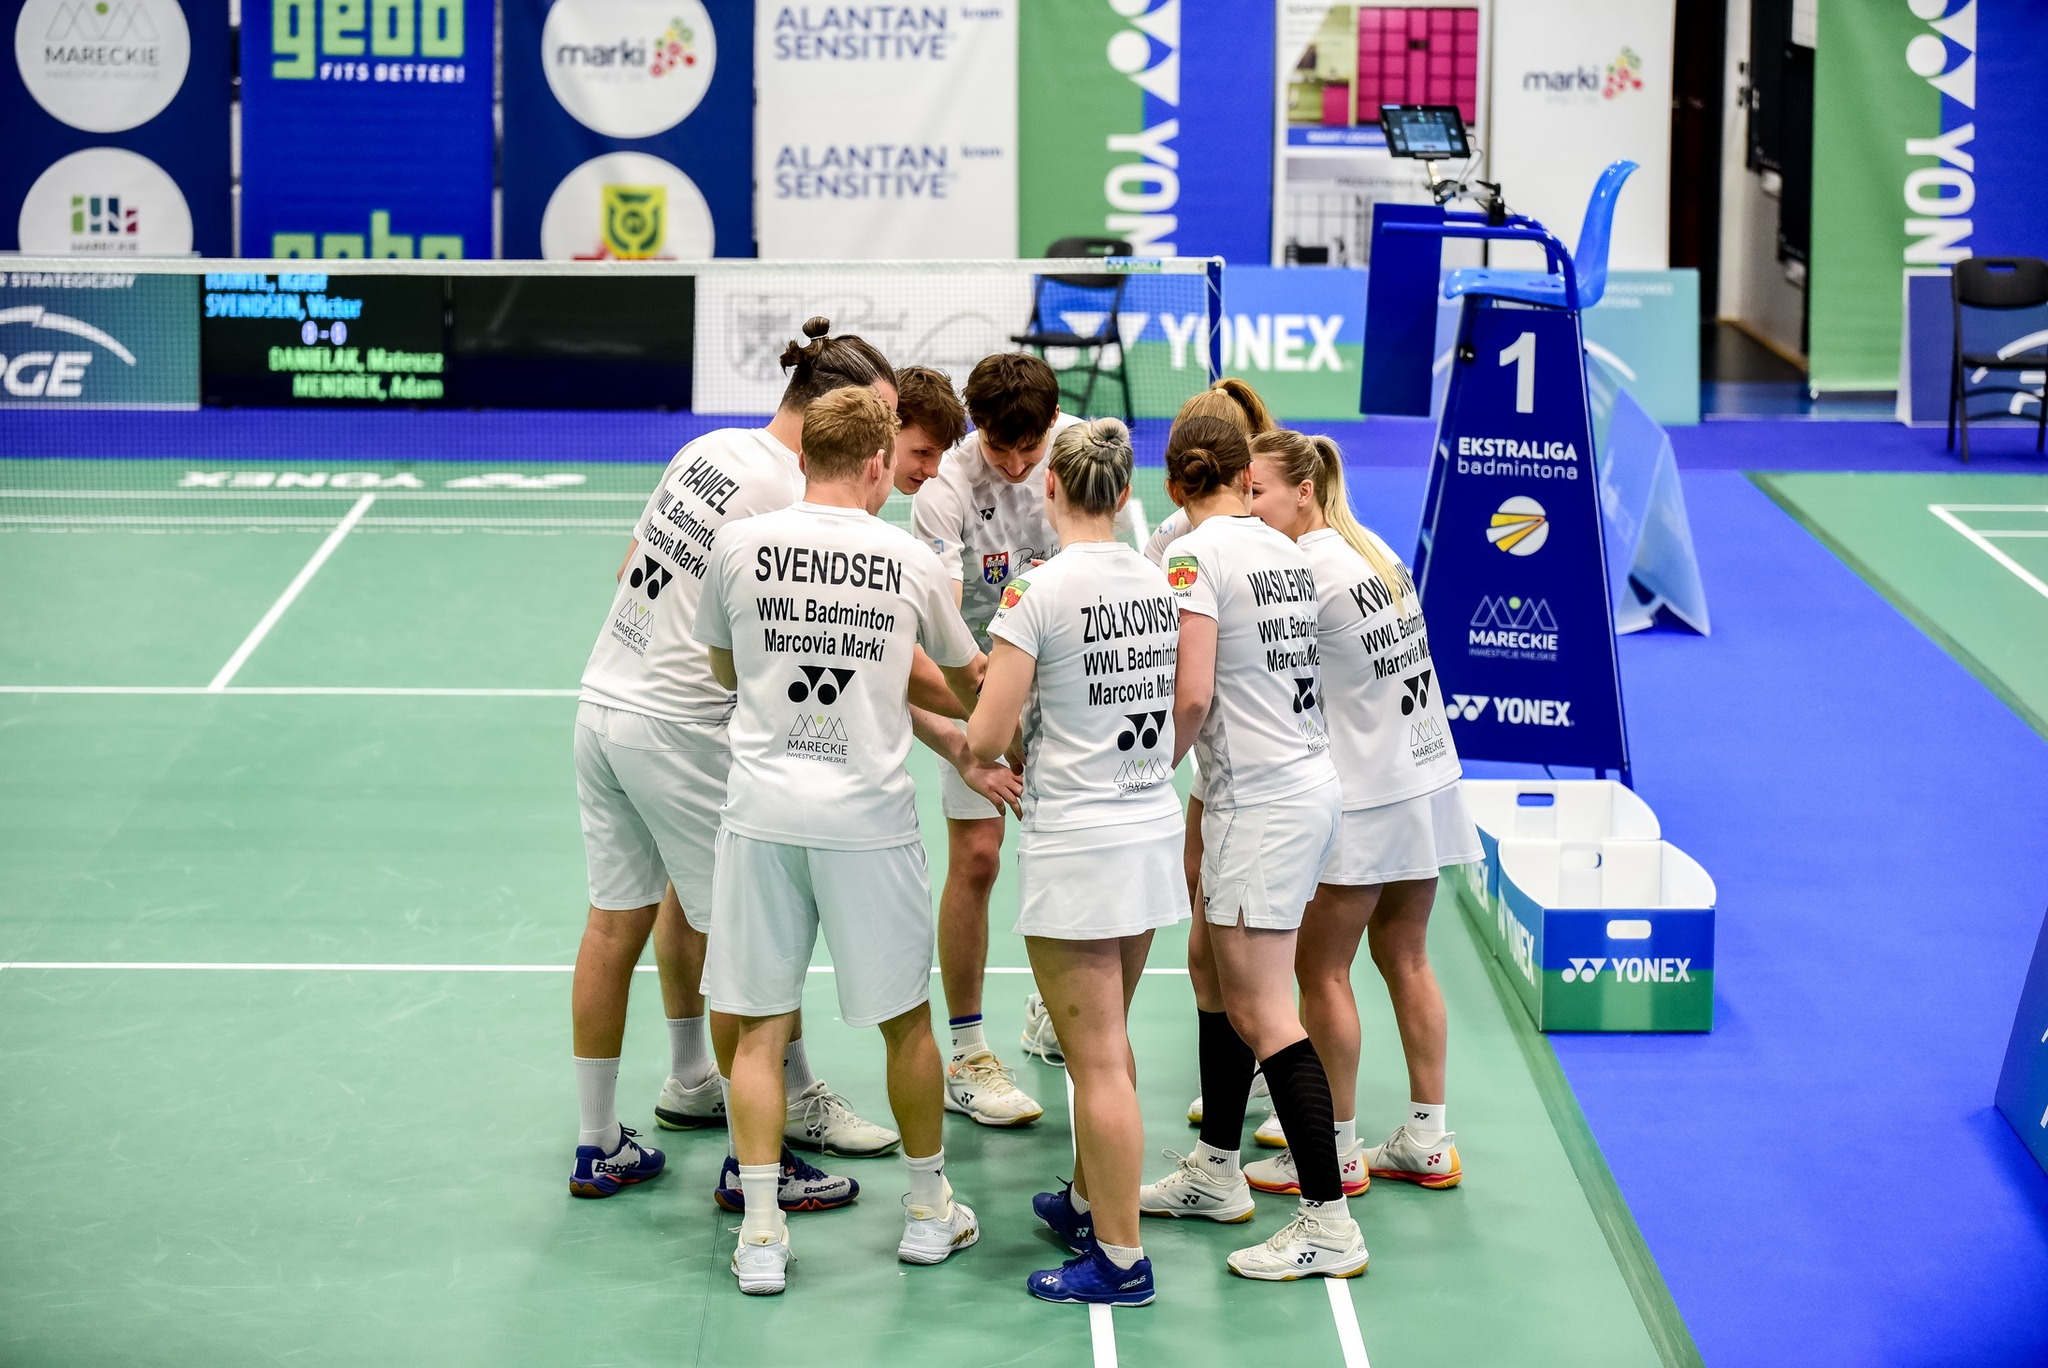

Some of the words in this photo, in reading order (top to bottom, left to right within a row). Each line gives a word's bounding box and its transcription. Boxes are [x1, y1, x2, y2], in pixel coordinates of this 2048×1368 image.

[775, 7, 947, 31] ALANTAN
[44, 45, 160, 66] MARECKIE
[557, 38, 645, 67] marki
[775, 34, 948, 60] SENSITIVE
[320, 62, 369, 81] FITS
[1523, 65, 1598, 92] marki
[776, 145, 947, 169] ALANTAN
[776, 173, 948, 199] SENSITIVE
[1160, 313, 1345, 372] YONEX
[1499, 332, 1536, 414] 1
[1458, 437, 1578, 461] EKSTRALIGA
[1457, 457, 1578, 480] badmintona
[679, 457, 740, 515] HAWEL
[755, 546, 902, 595] SVENDSEN
[756, 597, 800, 622] WWL
[805, 598, 895, 633] Badminton
[1081, 595, 1179, 643] ZIÓŁKOWSK
[1257, 617, 1289, 644] WWL
[1361, 624, 1399, 655] WWL
[1469, 629, 1559, 651] MARECKIE
[764, 628, 836, 655] Marcovia
[841, 632, 885, 662] Marki
[1084, 649, 1124, 676] WWL
[1374, 642, 1418, 680] Marcovia
[1089, 676, 1154, 706] Marcovia
[1493, 697, 1571, 727] YONEX
[787, 739, 848, 756] MARECKIE
[1611, 957, 1691, 983] YONEX
[804, 1181, 846, 1194] Babolat
